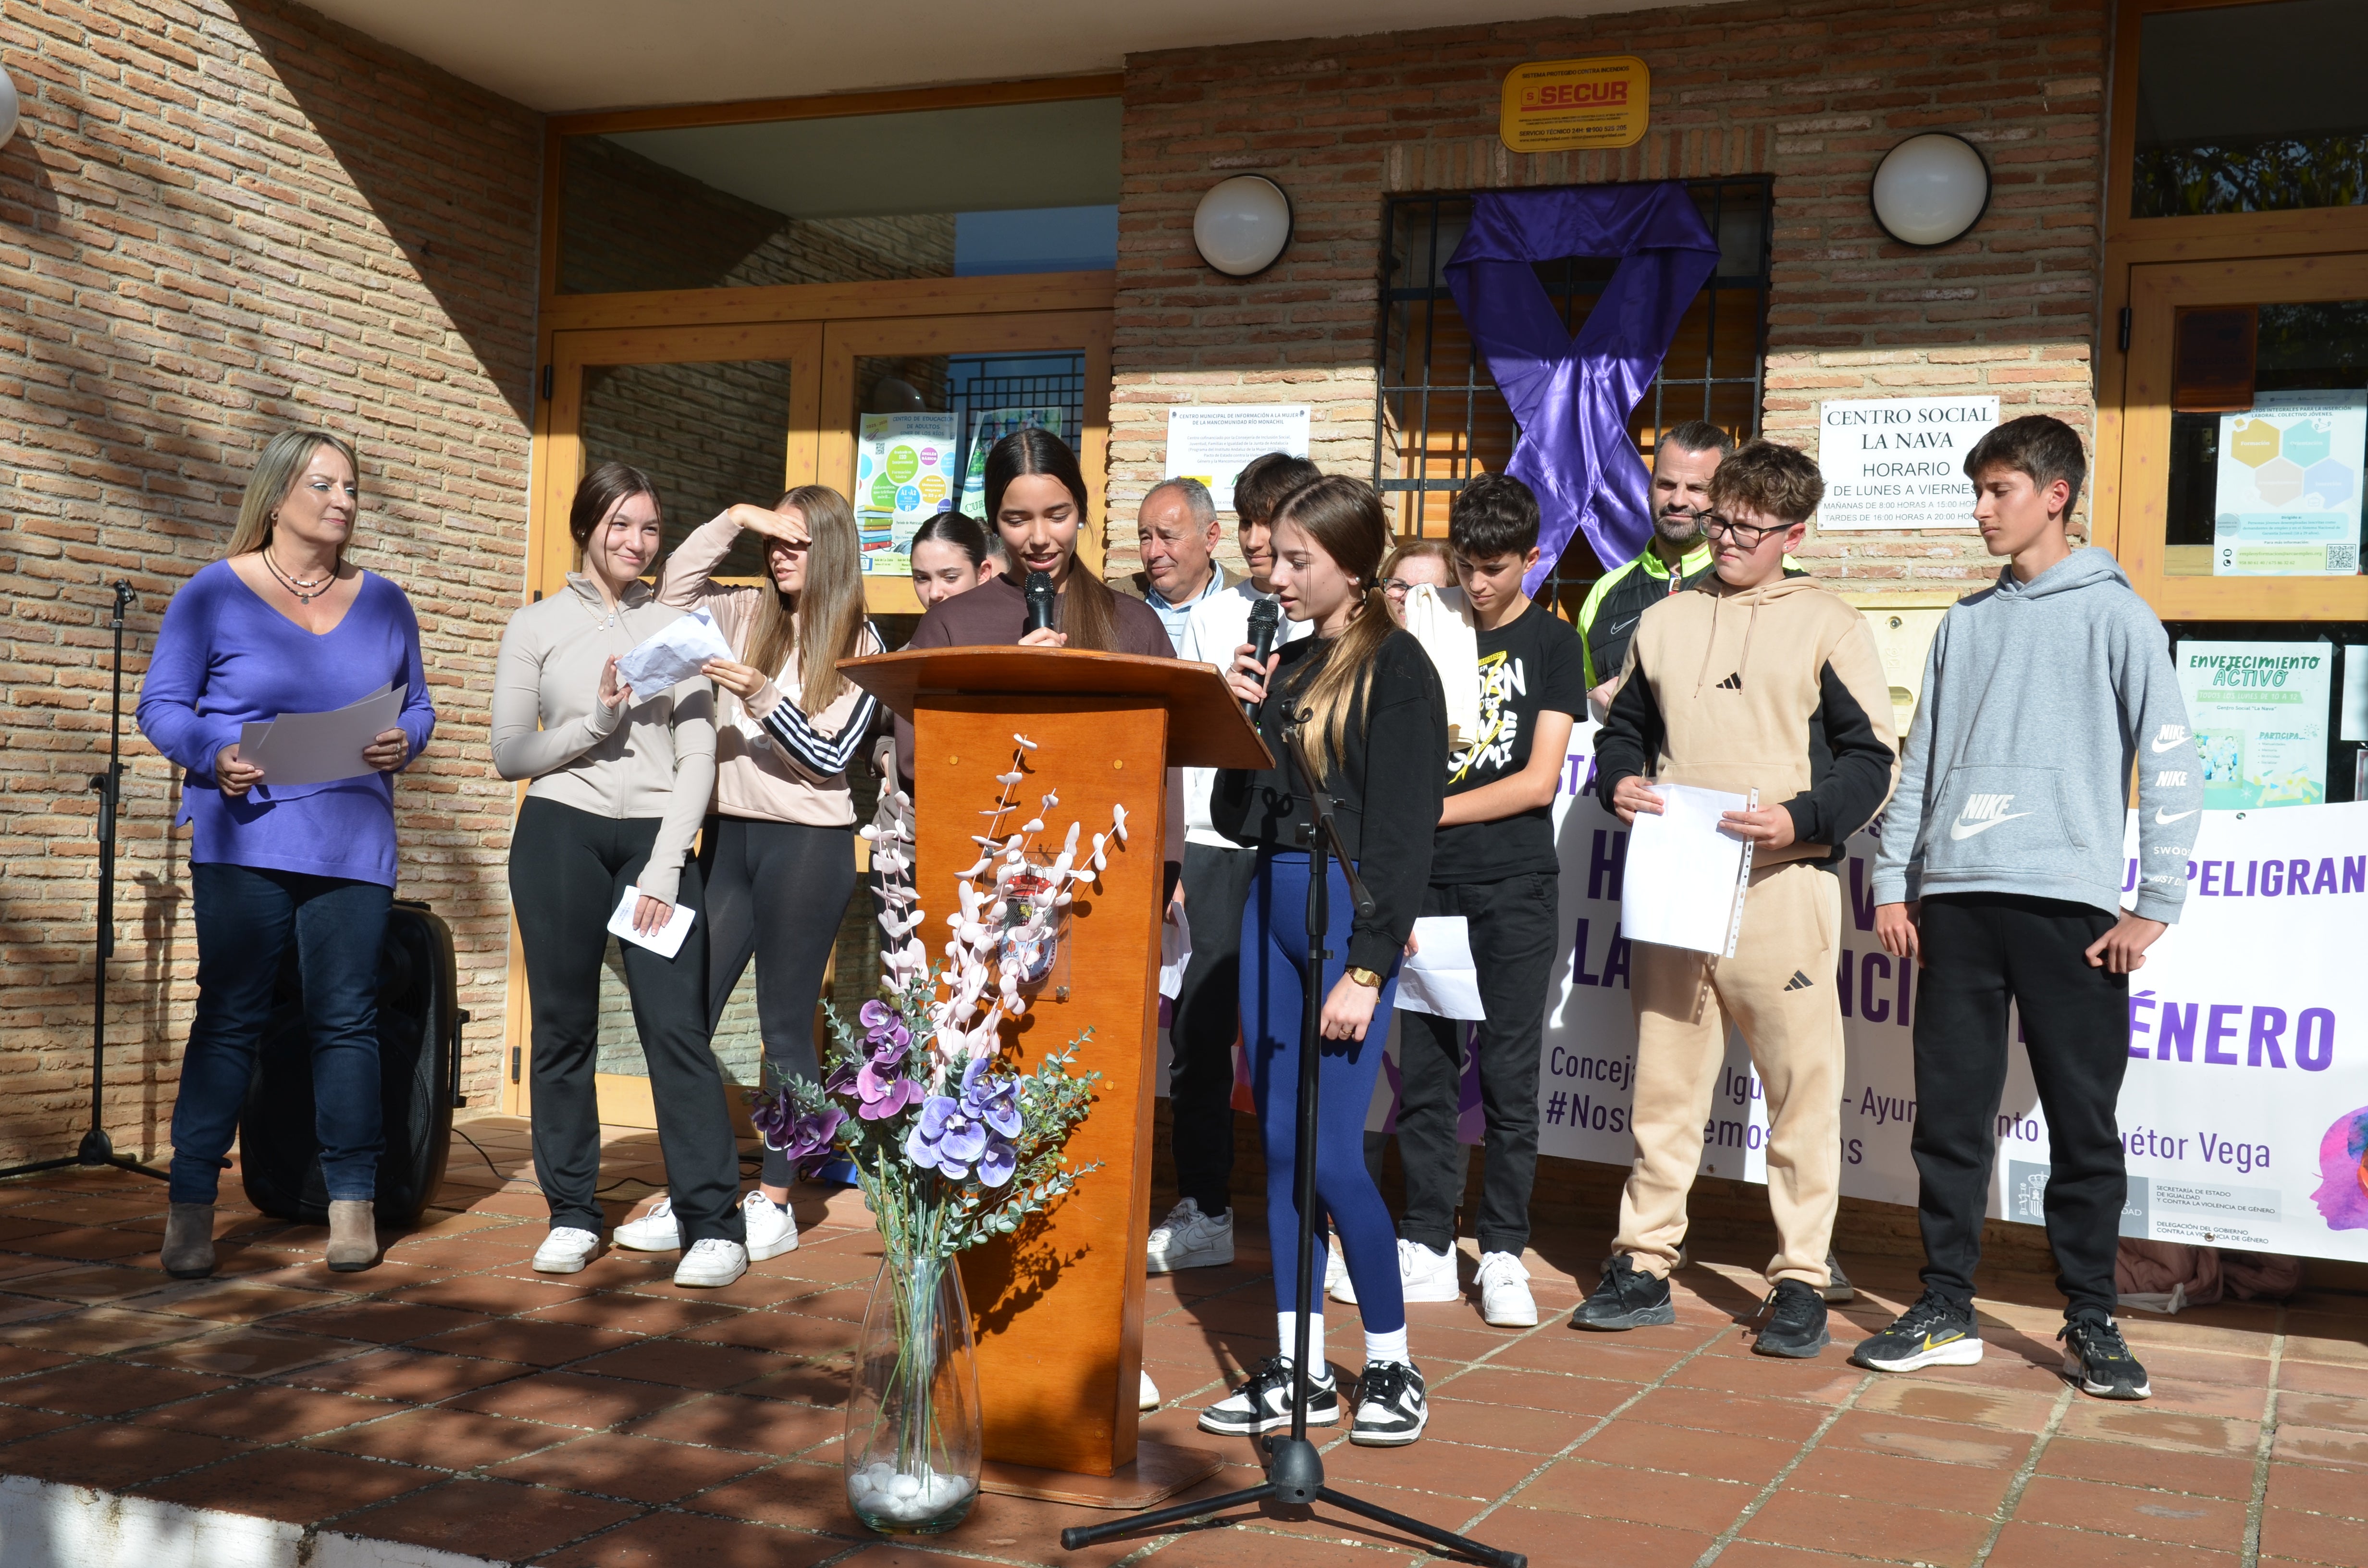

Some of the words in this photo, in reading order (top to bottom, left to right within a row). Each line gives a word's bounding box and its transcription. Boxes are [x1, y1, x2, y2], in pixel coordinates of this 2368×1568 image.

[1541, 81, 1628, 105] SECUR
[1827, 409, 1911, 426] CENTRO
[1918, 407, 1992, 423] SOCIAL
[1861, 434, 1888, 450] LA
[1895, 432, 1954, 449] NAVA
[1863, 462, 1950, 477] HORARIO
[1834, 486, 1851, 496] DE
[1856, 484, 1901, 496] LUNES
[1905, 485, 1914, 495] A
[1919, 483, 1975, 494] VIERNES
[1824, 501, 1863, 509] MAÑANAS
[2213, 669, 2288, 687] ACTIVO
[2158, 724, 2185, 740] NIKE
[2155, 771, 2187, 786] NIKE
[1961, 794, 2015, 819] NIKE
[2150, 875, 2174, 884] JUST
[2129, 990, 2335, 1072] ÉNERO
[1550, 1046, 1634, 1090] Concej
[2199, 1132, 2271, 1174] Vega
[2157, 1185, 2193, 1194] SECRETARÍA
[2167, 1192, 2200, 1200] IGUALDAD
[2201, 1201, 2235, 1210] VIOLENCIA
[2248, 1205, 2275, 1214] GÉNERO
[2157, 1221, 2200, 1230] DELEGACIÓN
[2213, 1227, 2248, 1235] GOBIERNO
[2242, 1235, 2269, 1244] GÉNERO
